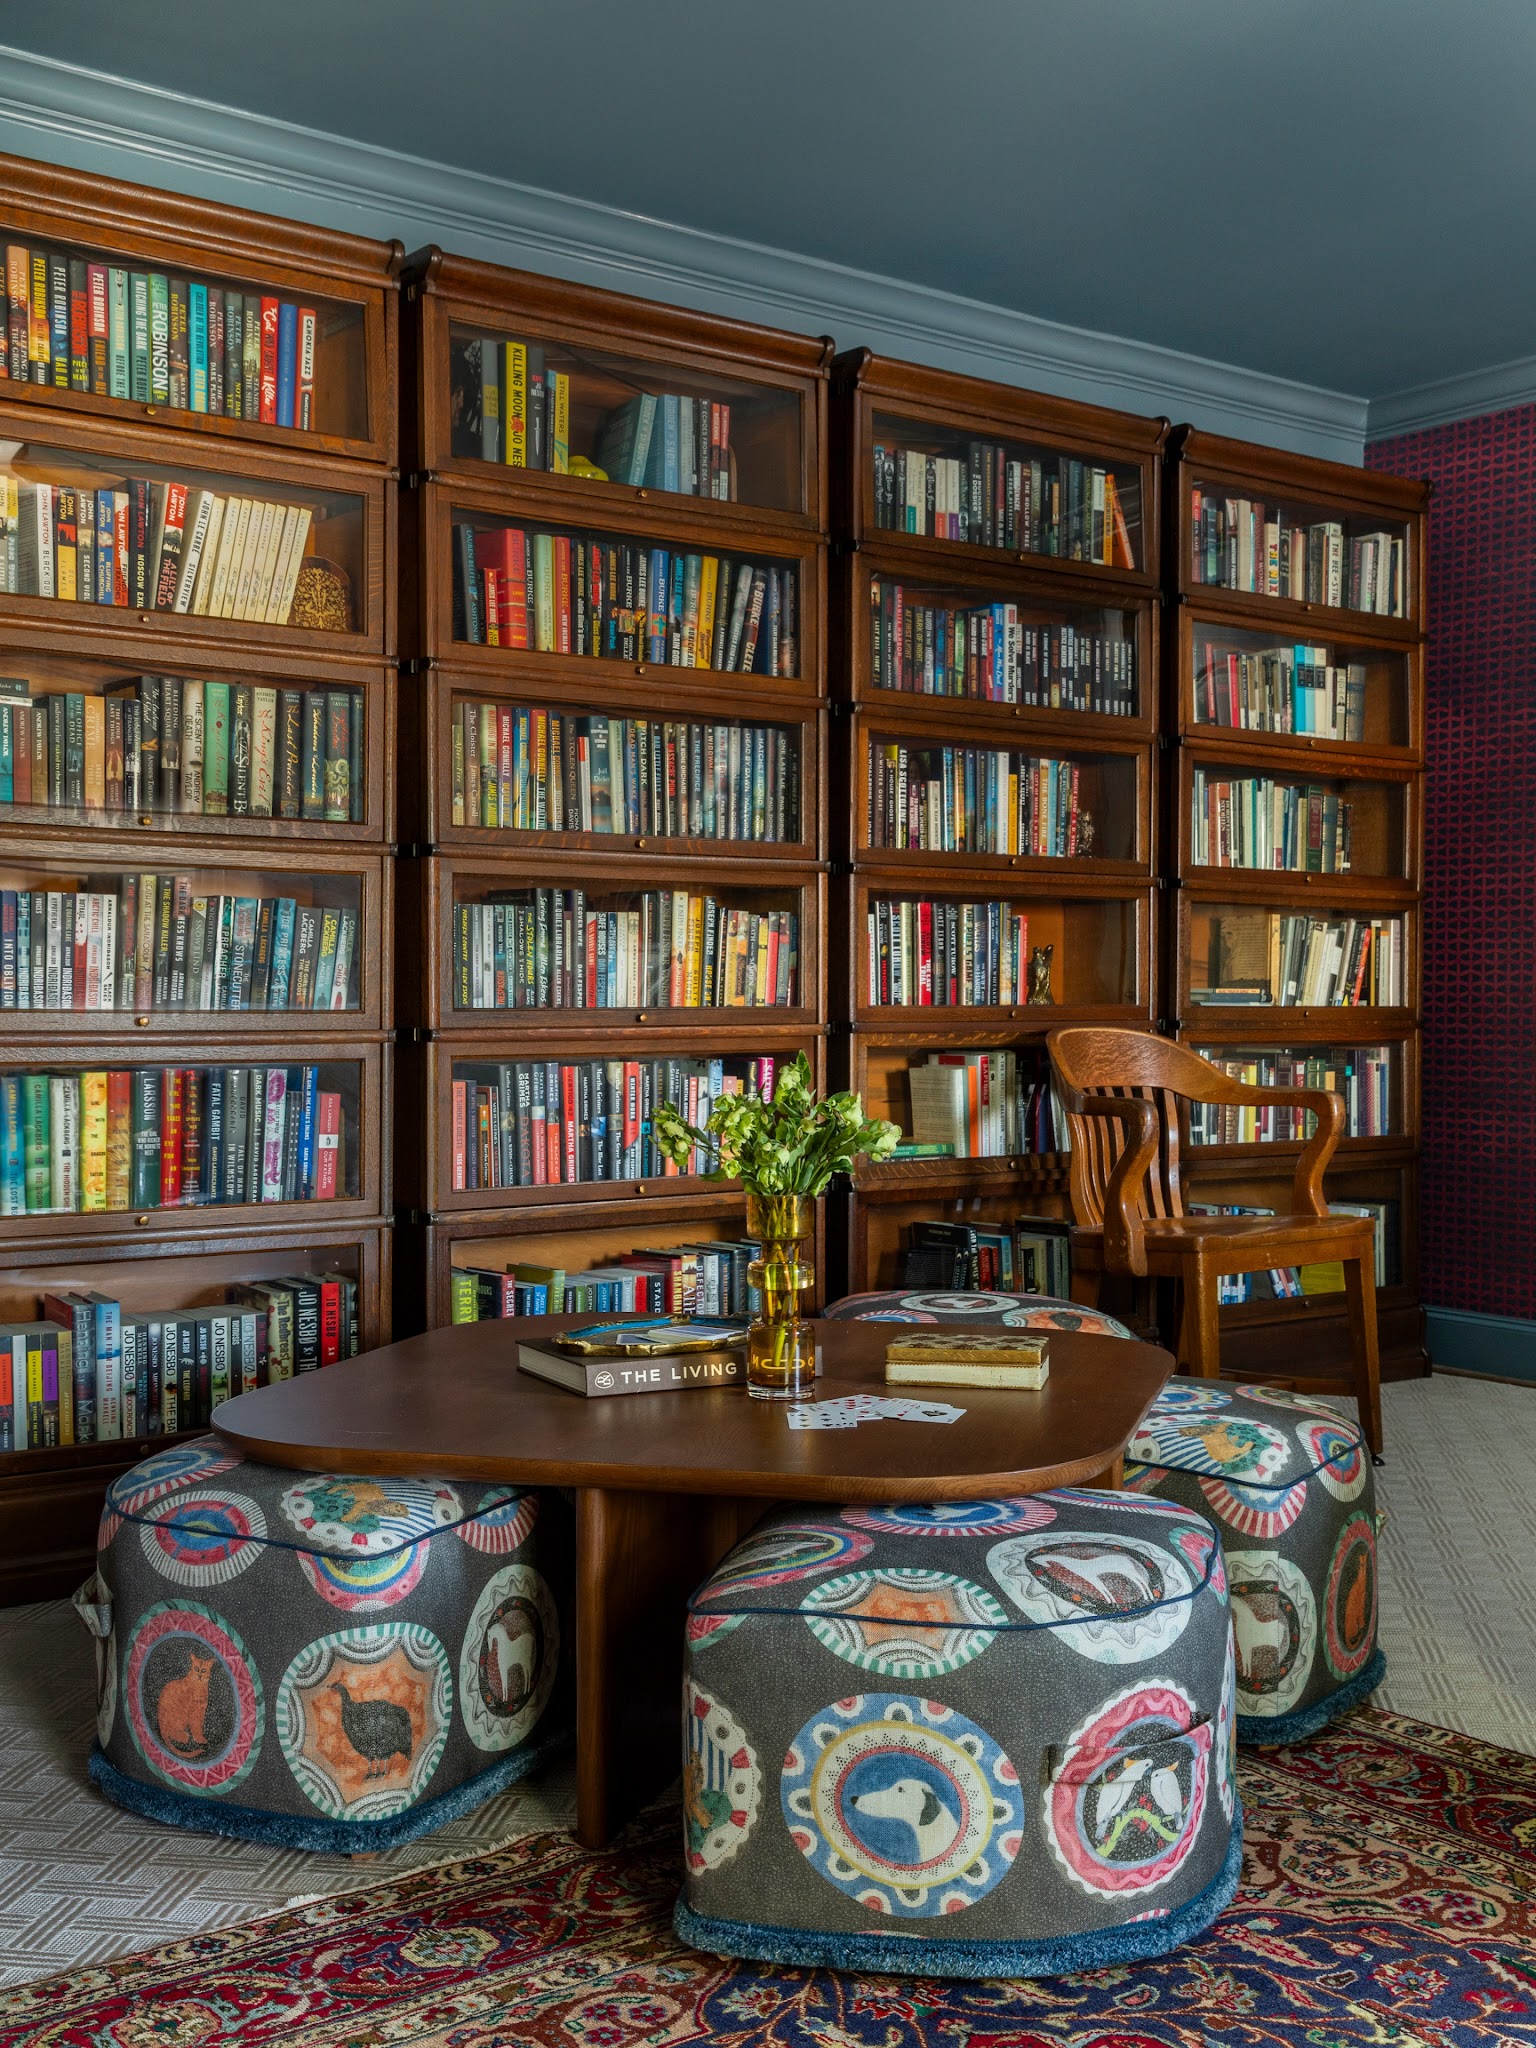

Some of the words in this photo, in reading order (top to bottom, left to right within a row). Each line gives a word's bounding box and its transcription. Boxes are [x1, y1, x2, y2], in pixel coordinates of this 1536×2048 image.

[34, 258, 45, 280] PETER
[54, 267, 66, 291] PETER
[93, 273, 103, 295] PETER
[135, 281, 146, 316] WATCHING
[55, 295, 66, 335] ROBINSON
[72, 299, 86, 356] ROBINSON
[94, 298, 104, 333] ROBINSON
[171, 293, 179, 341] ROBINSON
[136, 333, 147, 350] DARK
[153, 310, 168, 390] ROBINSON
[304, 318, 312, 354] CAHOKIA
[513, 348, 522, 386] KILLING
[513, 390, 523, 418] MOON
[168, 489, 178, 521] LAWTON
[657, 578, 665, 611] BURKE
[1269, 570, 1278, 592] NIX
[749, 590, 764, 625] BURKE
[1008, 627, 1015, 638] We
[743, 642, 756, 672] CLETE
[195, 719, 203, 745] SCENT
[502, 716, 510, 743] MICHAEL
[195, 746, 203, 757] OF
[537, 748, 545, 782] CONNELLY
[4, 939, 14, 960] INTO
[4, 965, 14, 1006] OBLIVION
[143, 1078, 156, 1121] LARSSON
[212, 1083, 221, 1106] FATAL
[254, 1098, 262, 1122] MUSIC
[211, 1110, 220, 1140] GAMBIT
[298, 1291, 317, 1305] JO
[459, 1280, 472, 1323] TERRY
[506, 1290, 514, 1316] SECRET
[124, 1331, 134, 1344] JO
[166, 1327, 175, 1340] JO
[299, 1309, 318, 1344] NESBØ
[620, 1368, 661, 1384] THE
[671, 1362, 738, 1381] LIVING
